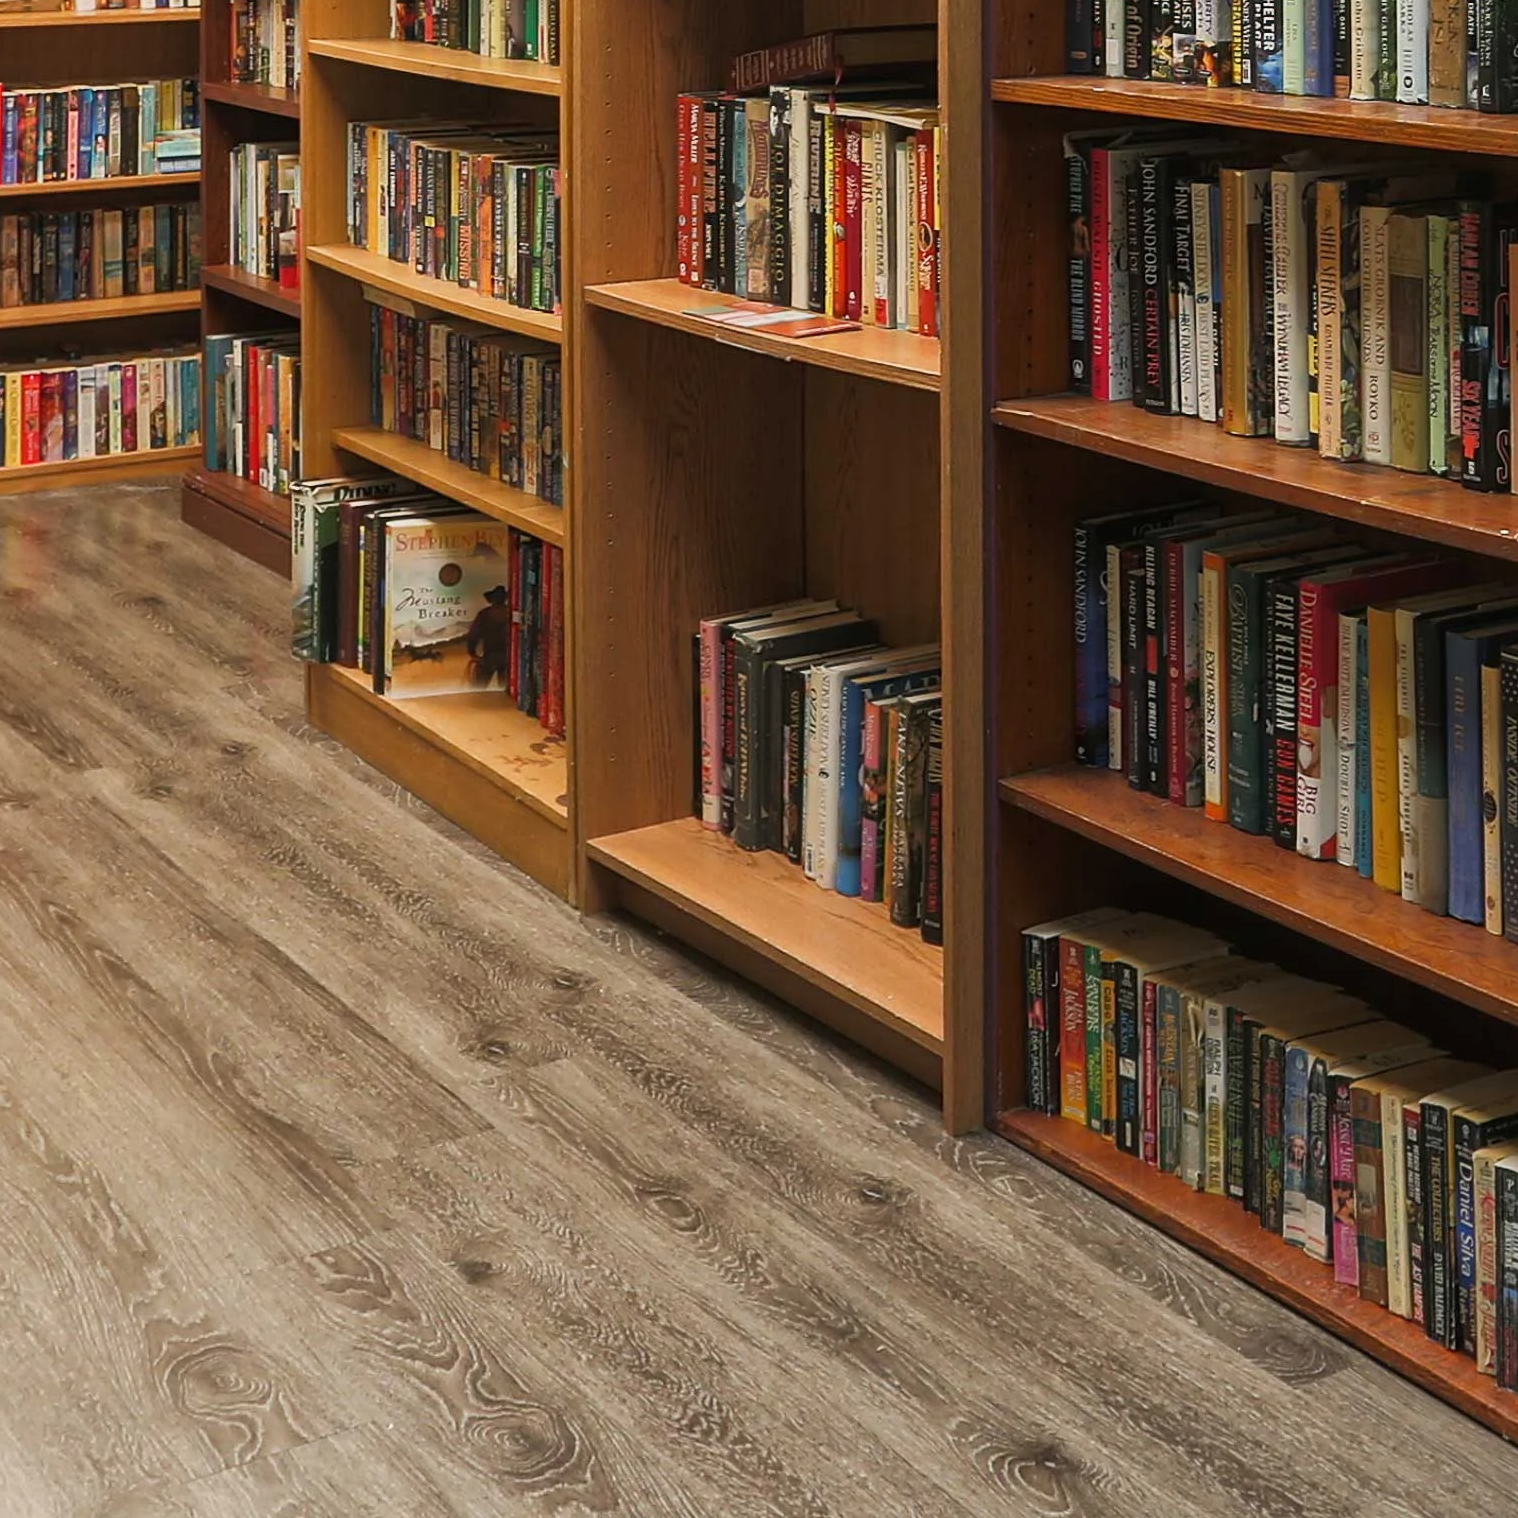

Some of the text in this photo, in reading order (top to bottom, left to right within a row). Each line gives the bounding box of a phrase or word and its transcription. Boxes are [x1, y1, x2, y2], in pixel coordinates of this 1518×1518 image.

[1142, 160, 1157, 285] JOHN SANDFORD
[1369, 374, 1379, 421] ROYKO
[395, 528, 472, 554] STEPHEN
[418, 608, 467, 619] Breaker
[1276, 594, 1295, 732] FAYE KELLERMAN
[1276, 738, 1295, 827] GUN GAMES
[1458, 1163, 1474, 1278] Daniel Silva
